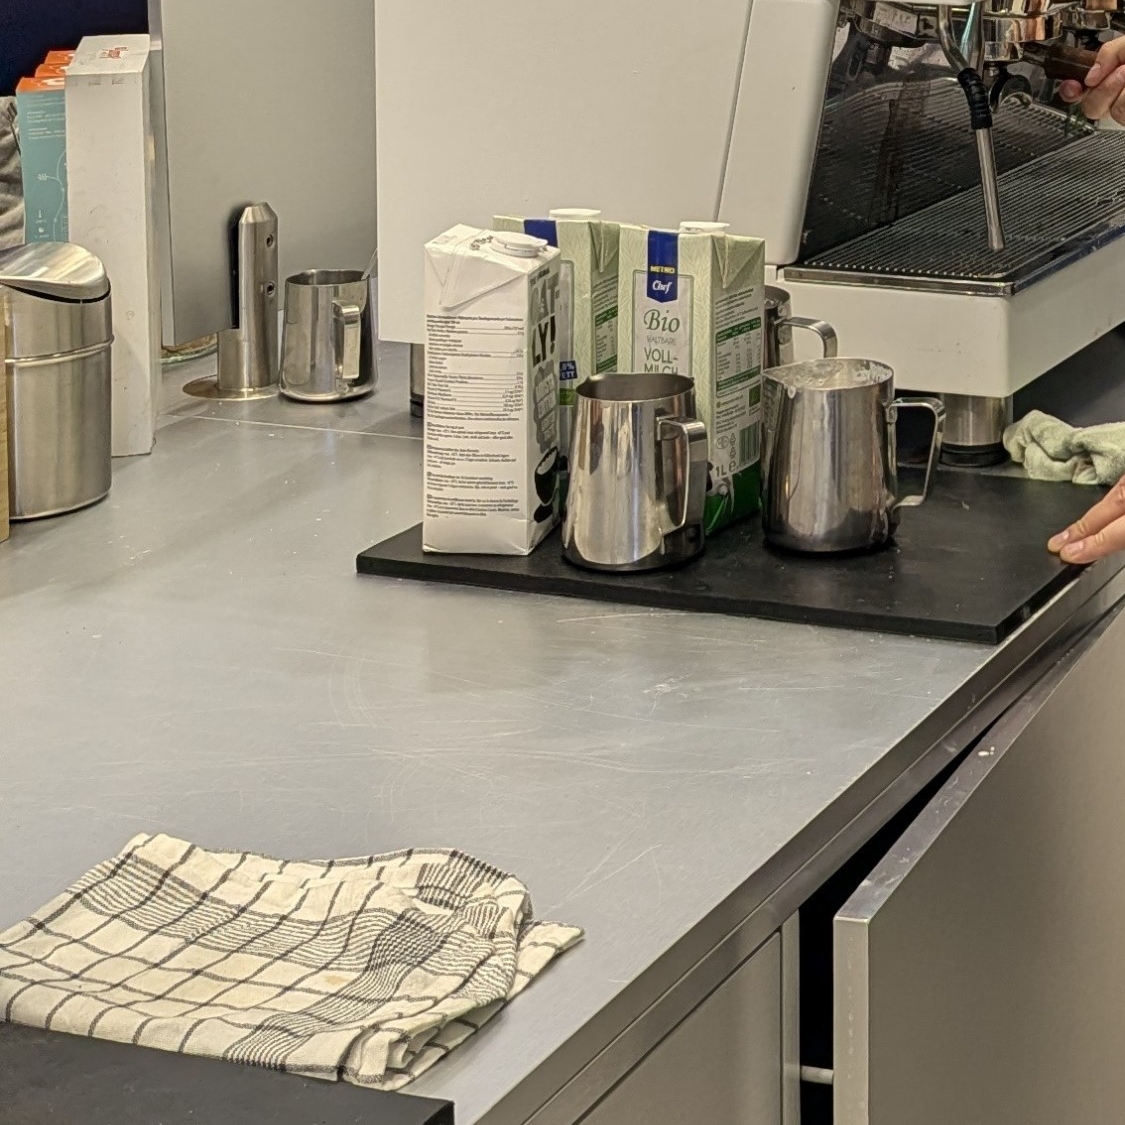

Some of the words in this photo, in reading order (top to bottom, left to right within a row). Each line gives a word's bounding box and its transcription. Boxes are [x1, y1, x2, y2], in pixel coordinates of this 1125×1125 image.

[652, 280, 672, 294] Chef
[643, 308, 680, 333] Bio
[644, 347, 678, 364] VOLL-
[644, 363, 679, 374] MILCH
